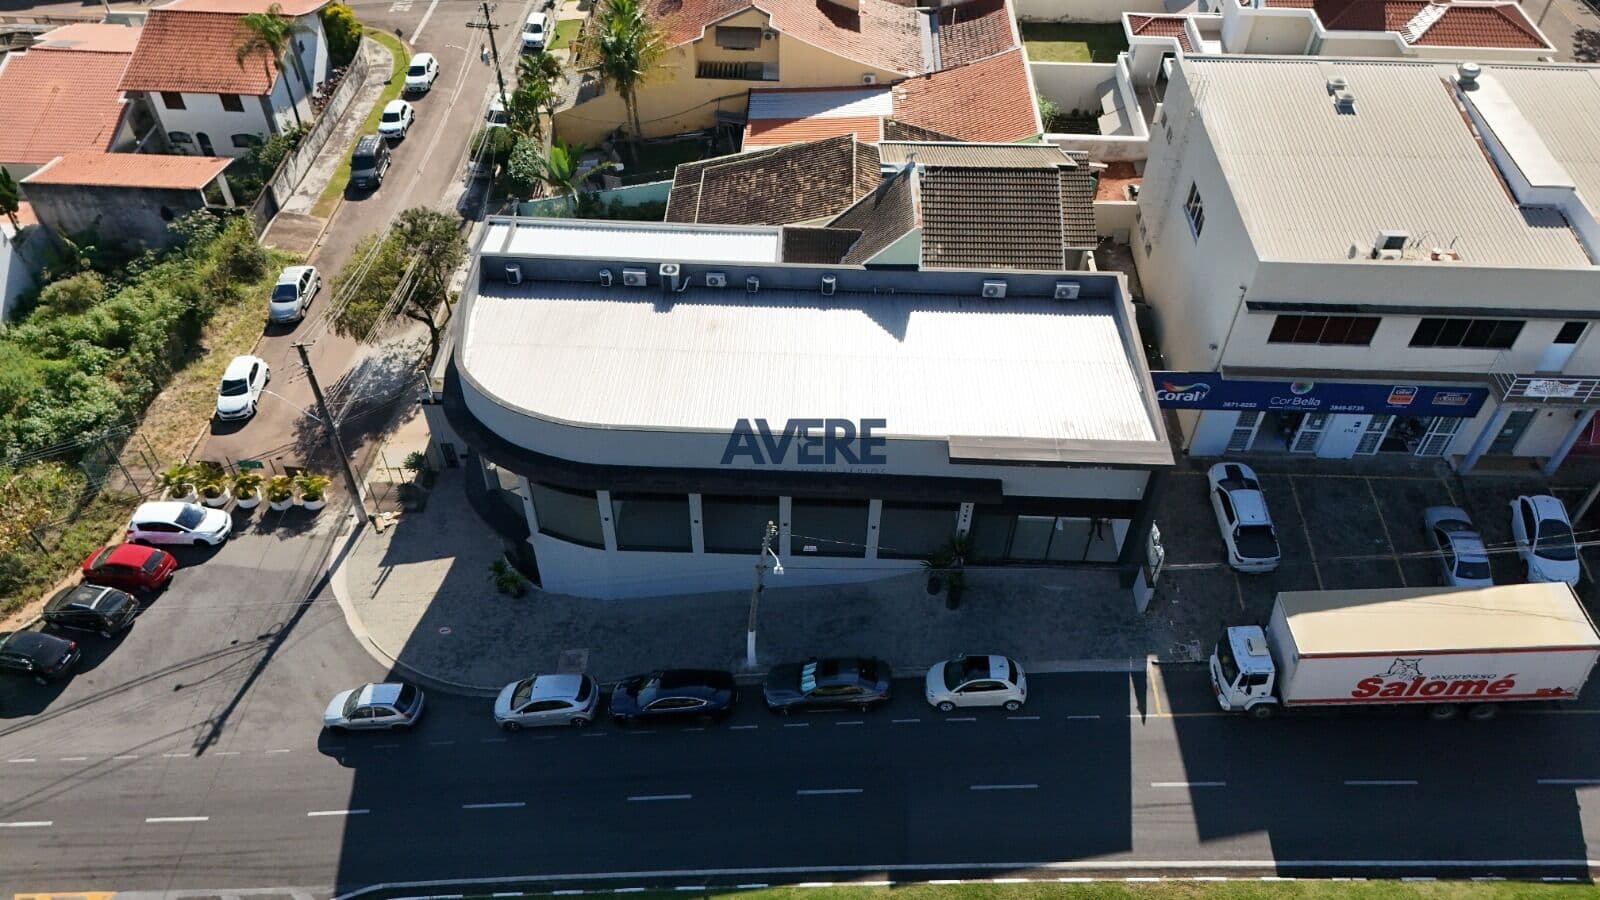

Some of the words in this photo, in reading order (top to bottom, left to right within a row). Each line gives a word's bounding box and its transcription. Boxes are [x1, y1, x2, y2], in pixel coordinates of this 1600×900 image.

[1156, 389, 1201, 402] Coral
[1430, 673, 1497, 682] expresso
[1351, 673, 1519, 698] Salomé
